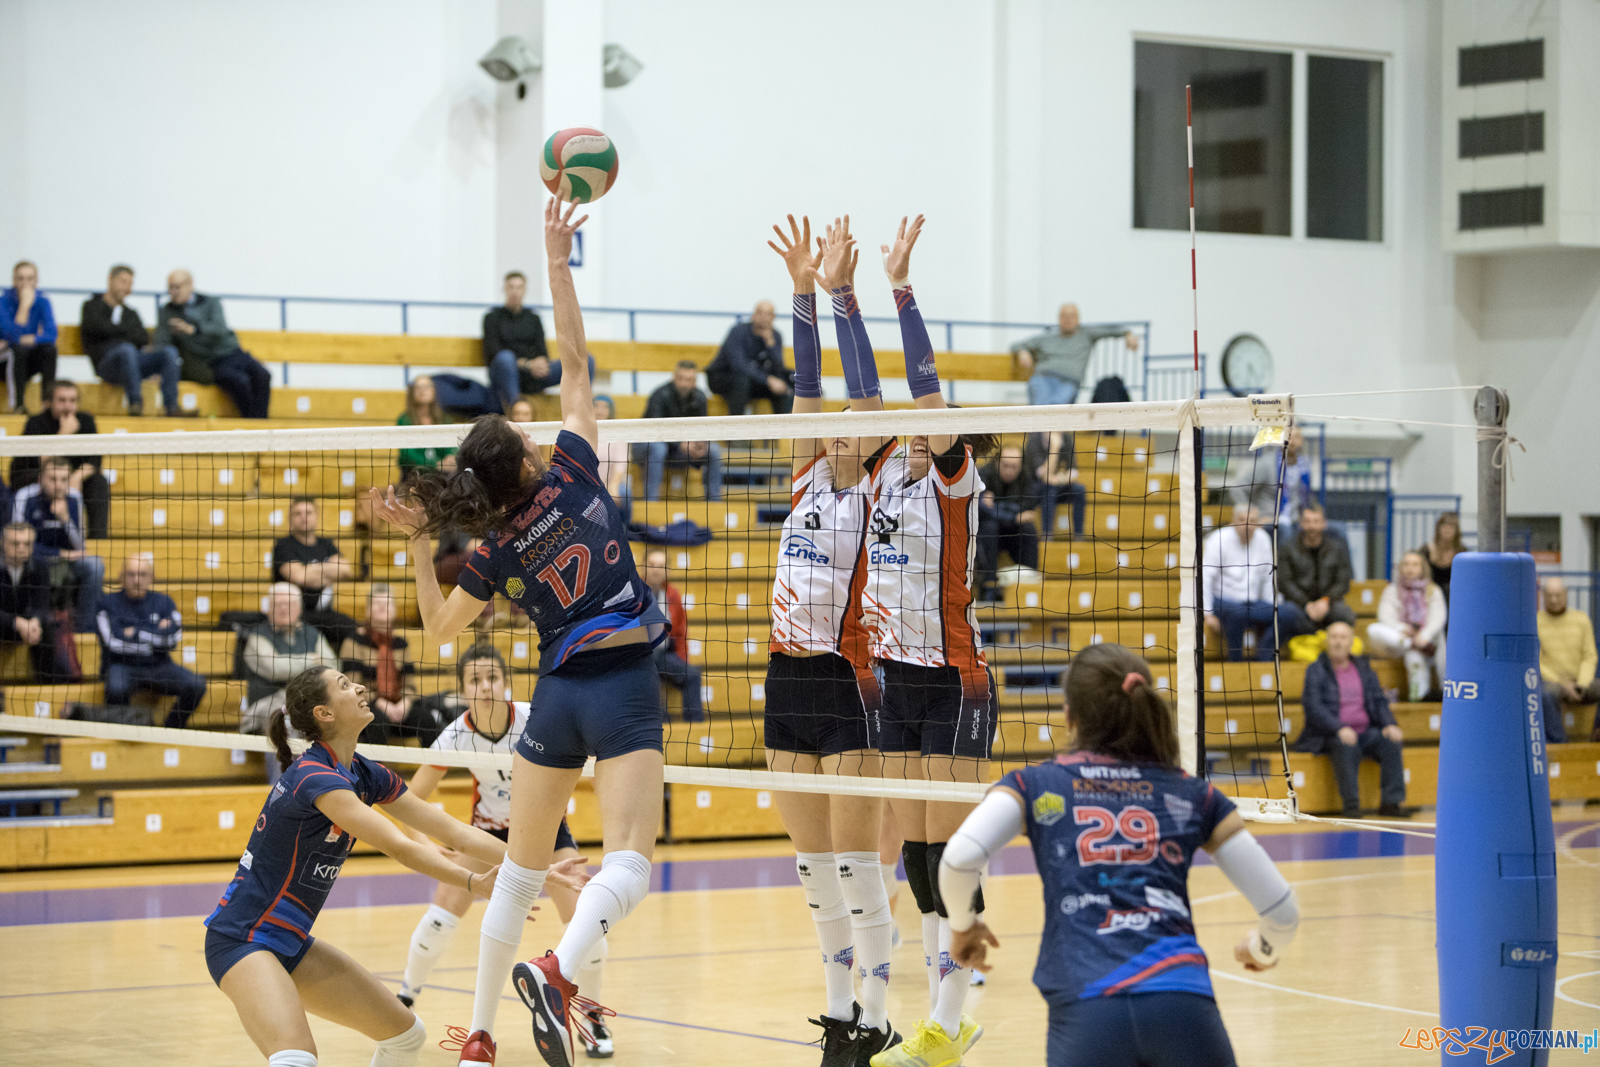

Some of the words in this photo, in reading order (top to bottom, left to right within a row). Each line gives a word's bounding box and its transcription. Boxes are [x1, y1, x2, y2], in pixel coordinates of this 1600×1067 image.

[513, 507, 563, 553] JAKÓBIAK
[520, 517, 573, 567] KROSNO
[783, 542, 830, 566] Enea
[525, 546, 555, 574] MIASTO
[535, 543, 591, 609] 17
[870, 550, 909, 565] Enea
[1527, 693, 1544, 775] Senoh
[1072, 805, 1160, 867] 29
